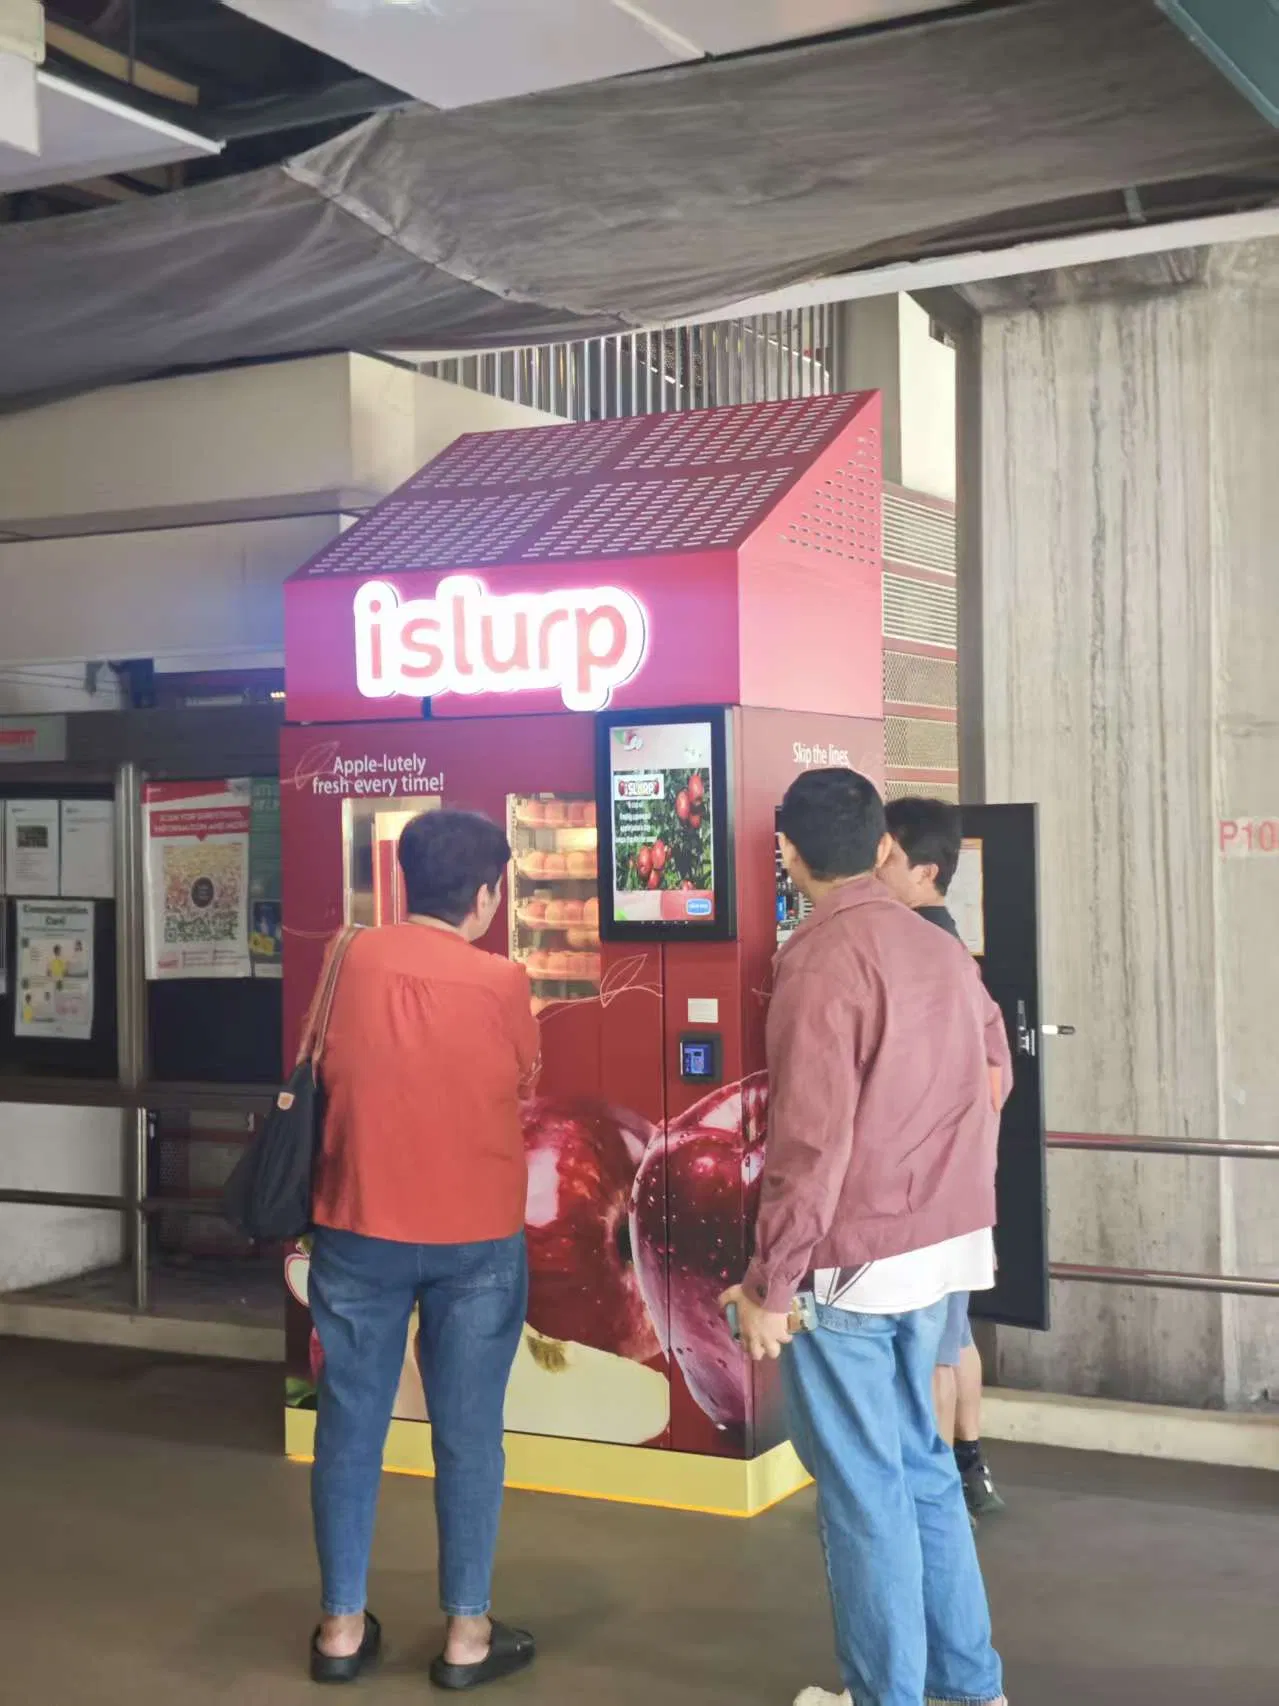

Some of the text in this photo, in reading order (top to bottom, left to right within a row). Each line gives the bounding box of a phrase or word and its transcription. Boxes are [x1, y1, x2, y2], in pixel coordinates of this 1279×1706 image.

[362, 588, 634, 700] islurp
[333, 752, 426, 776] Apple-lutely
[792, 742, 811, 769] Skip
[812, 744, 827, 764] the
[312, 772, 444, 797] fresh every time!
